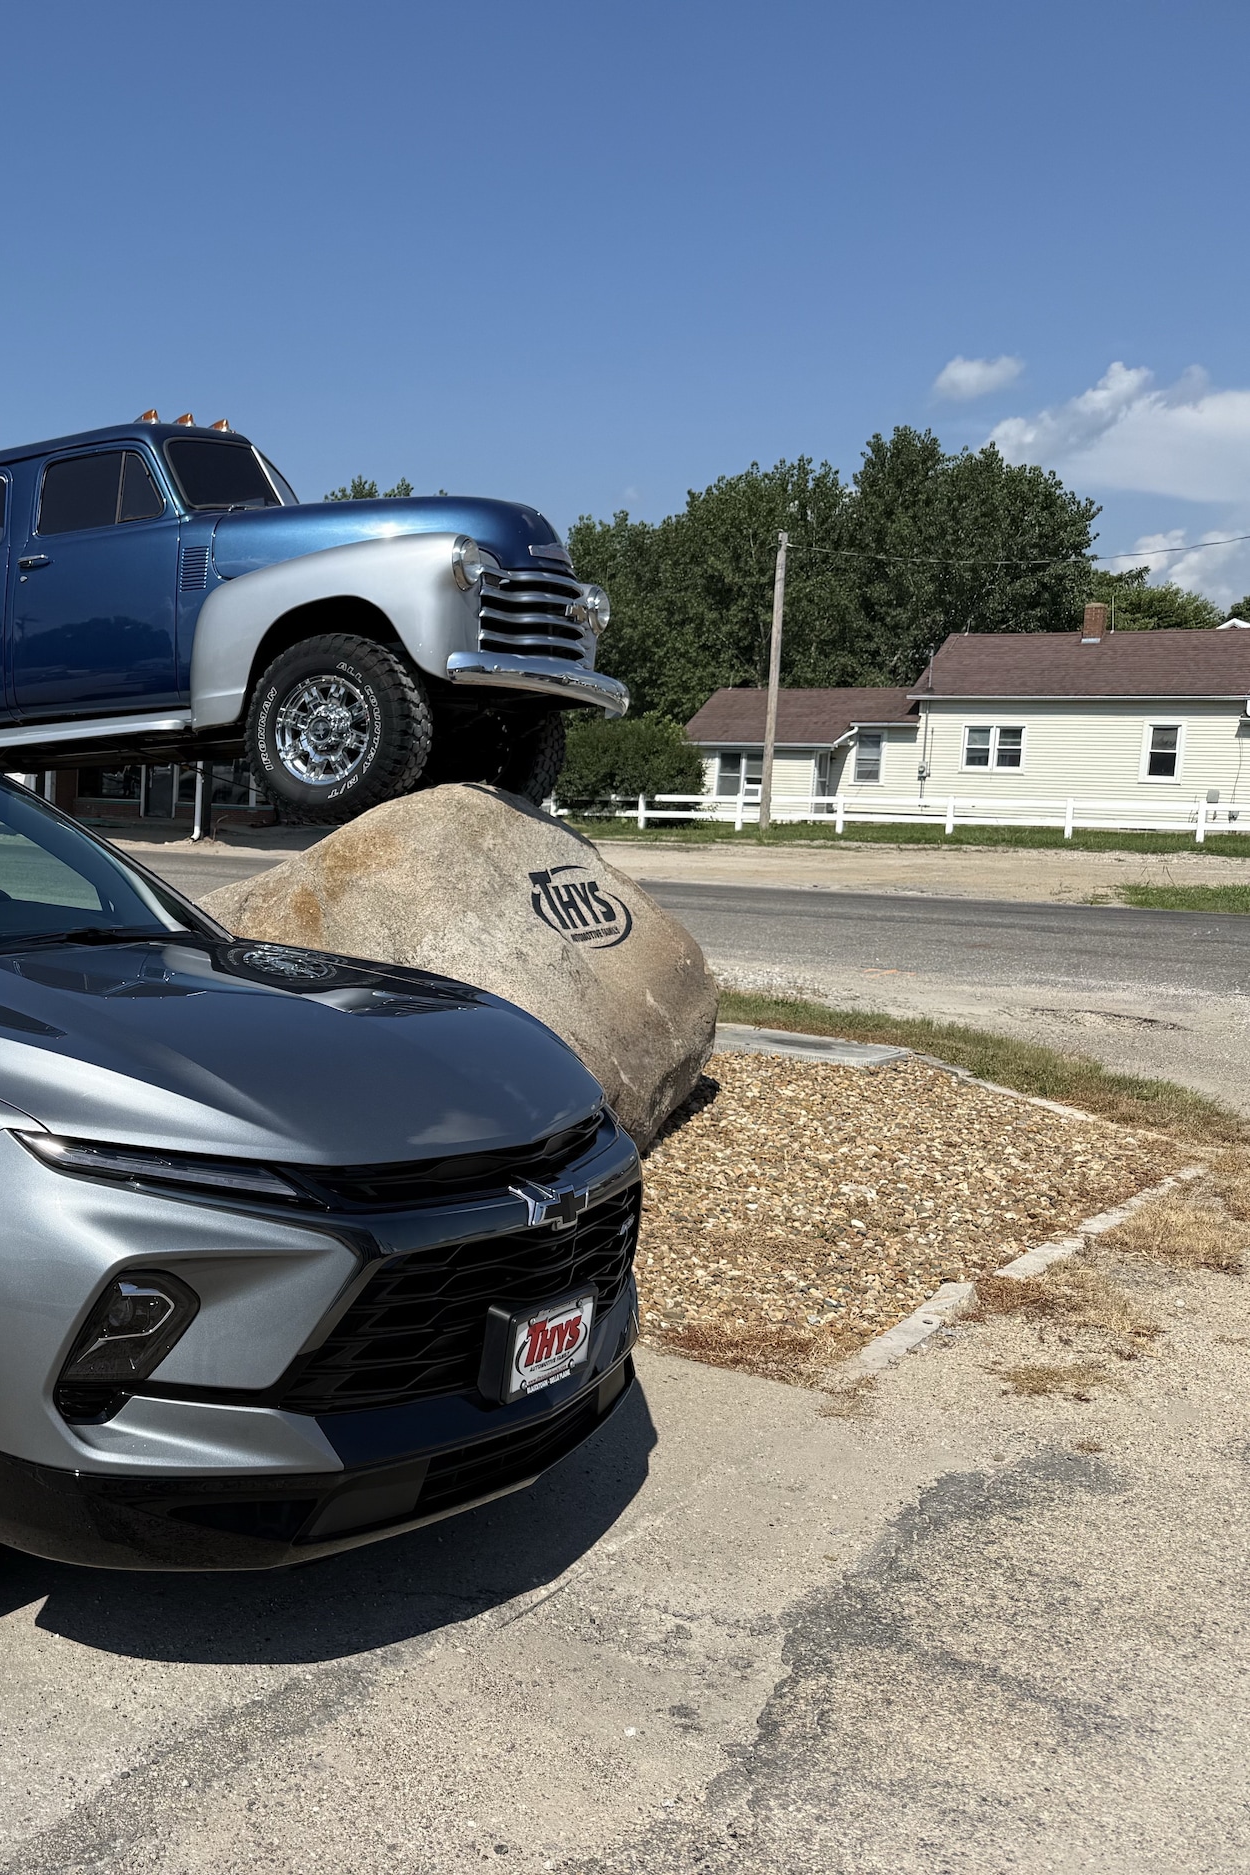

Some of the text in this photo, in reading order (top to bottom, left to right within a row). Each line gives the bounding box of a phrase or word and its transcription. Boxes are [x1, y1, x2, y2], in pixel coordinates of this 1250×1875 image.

[257, 686, 278, 772] IRONMAN
[336, 661, 363, 684] ALL
[363, 684, 382, 774] COUNTRY
[528, 868, 617, 930] THYS
[524, 1315, 582, 1368] THYS
